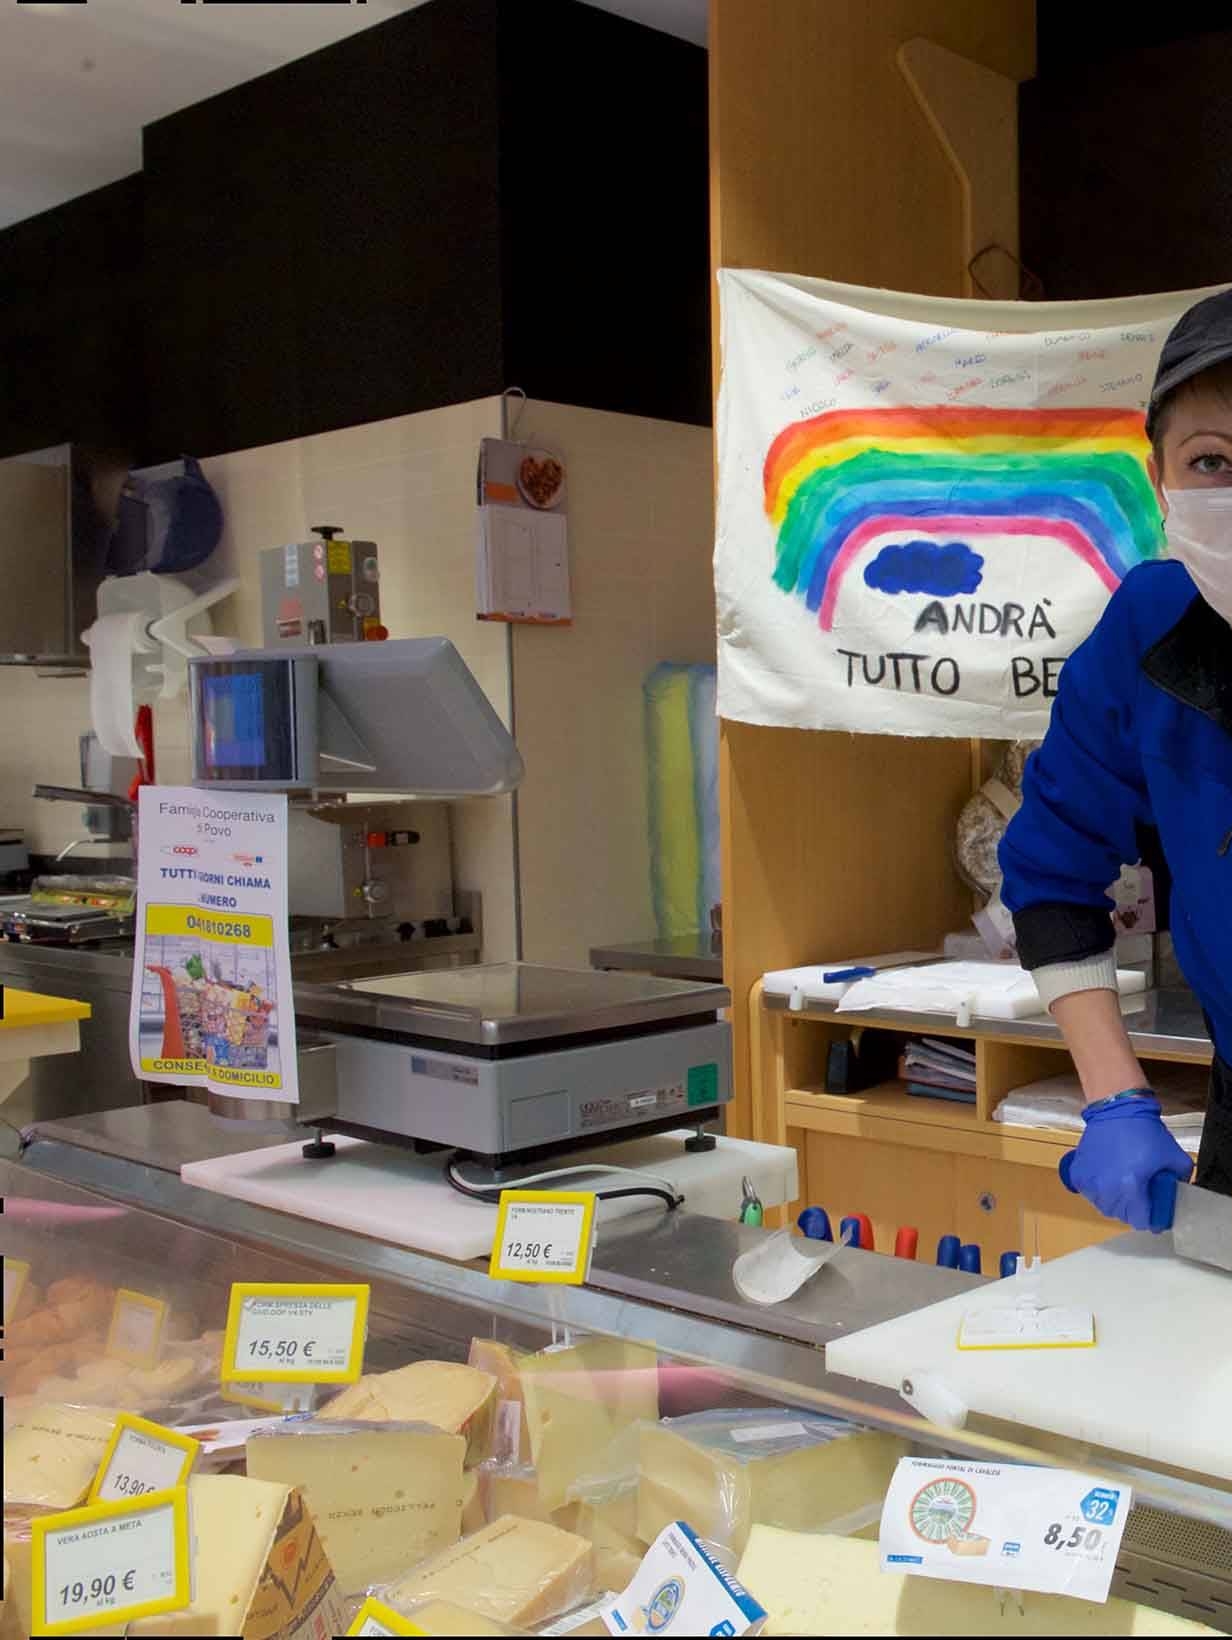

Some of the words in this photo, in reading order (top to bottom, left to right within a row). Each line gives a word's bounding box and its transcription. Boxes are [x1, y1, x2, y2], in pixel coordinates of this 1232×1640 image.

[914, 597, 1057, 640] ANDRÀ
[836, 647, 961, 696] TUTTO
[202, 806, 276, 823] Cooperativa
[204, 823, 232, 837] Povo
[226, 875, 271, 889] CHIAMA
[219, 1069, 275, 1085] DOMICILIO
[507, 1242, 541, 1260] 12,50
[543, 1243, 553, 1259] €
[248, 1339, 298, 1359] 15,50
[303, 1341, 317, 1357] €
[113, 1472, 145, 1496] 13,90
[1086, 1501, 1108, 1521] 32
[57, 1534, 80, 1546] VERA
[82, 1528, 110, 1542] AOSTA
[120, 1519, 143, 1532] META
[1043, 1523, 1104, 1552] 8,50
[60, 1574, 116, 1607] 19,90
[122, 1569, 137, 1591] €
